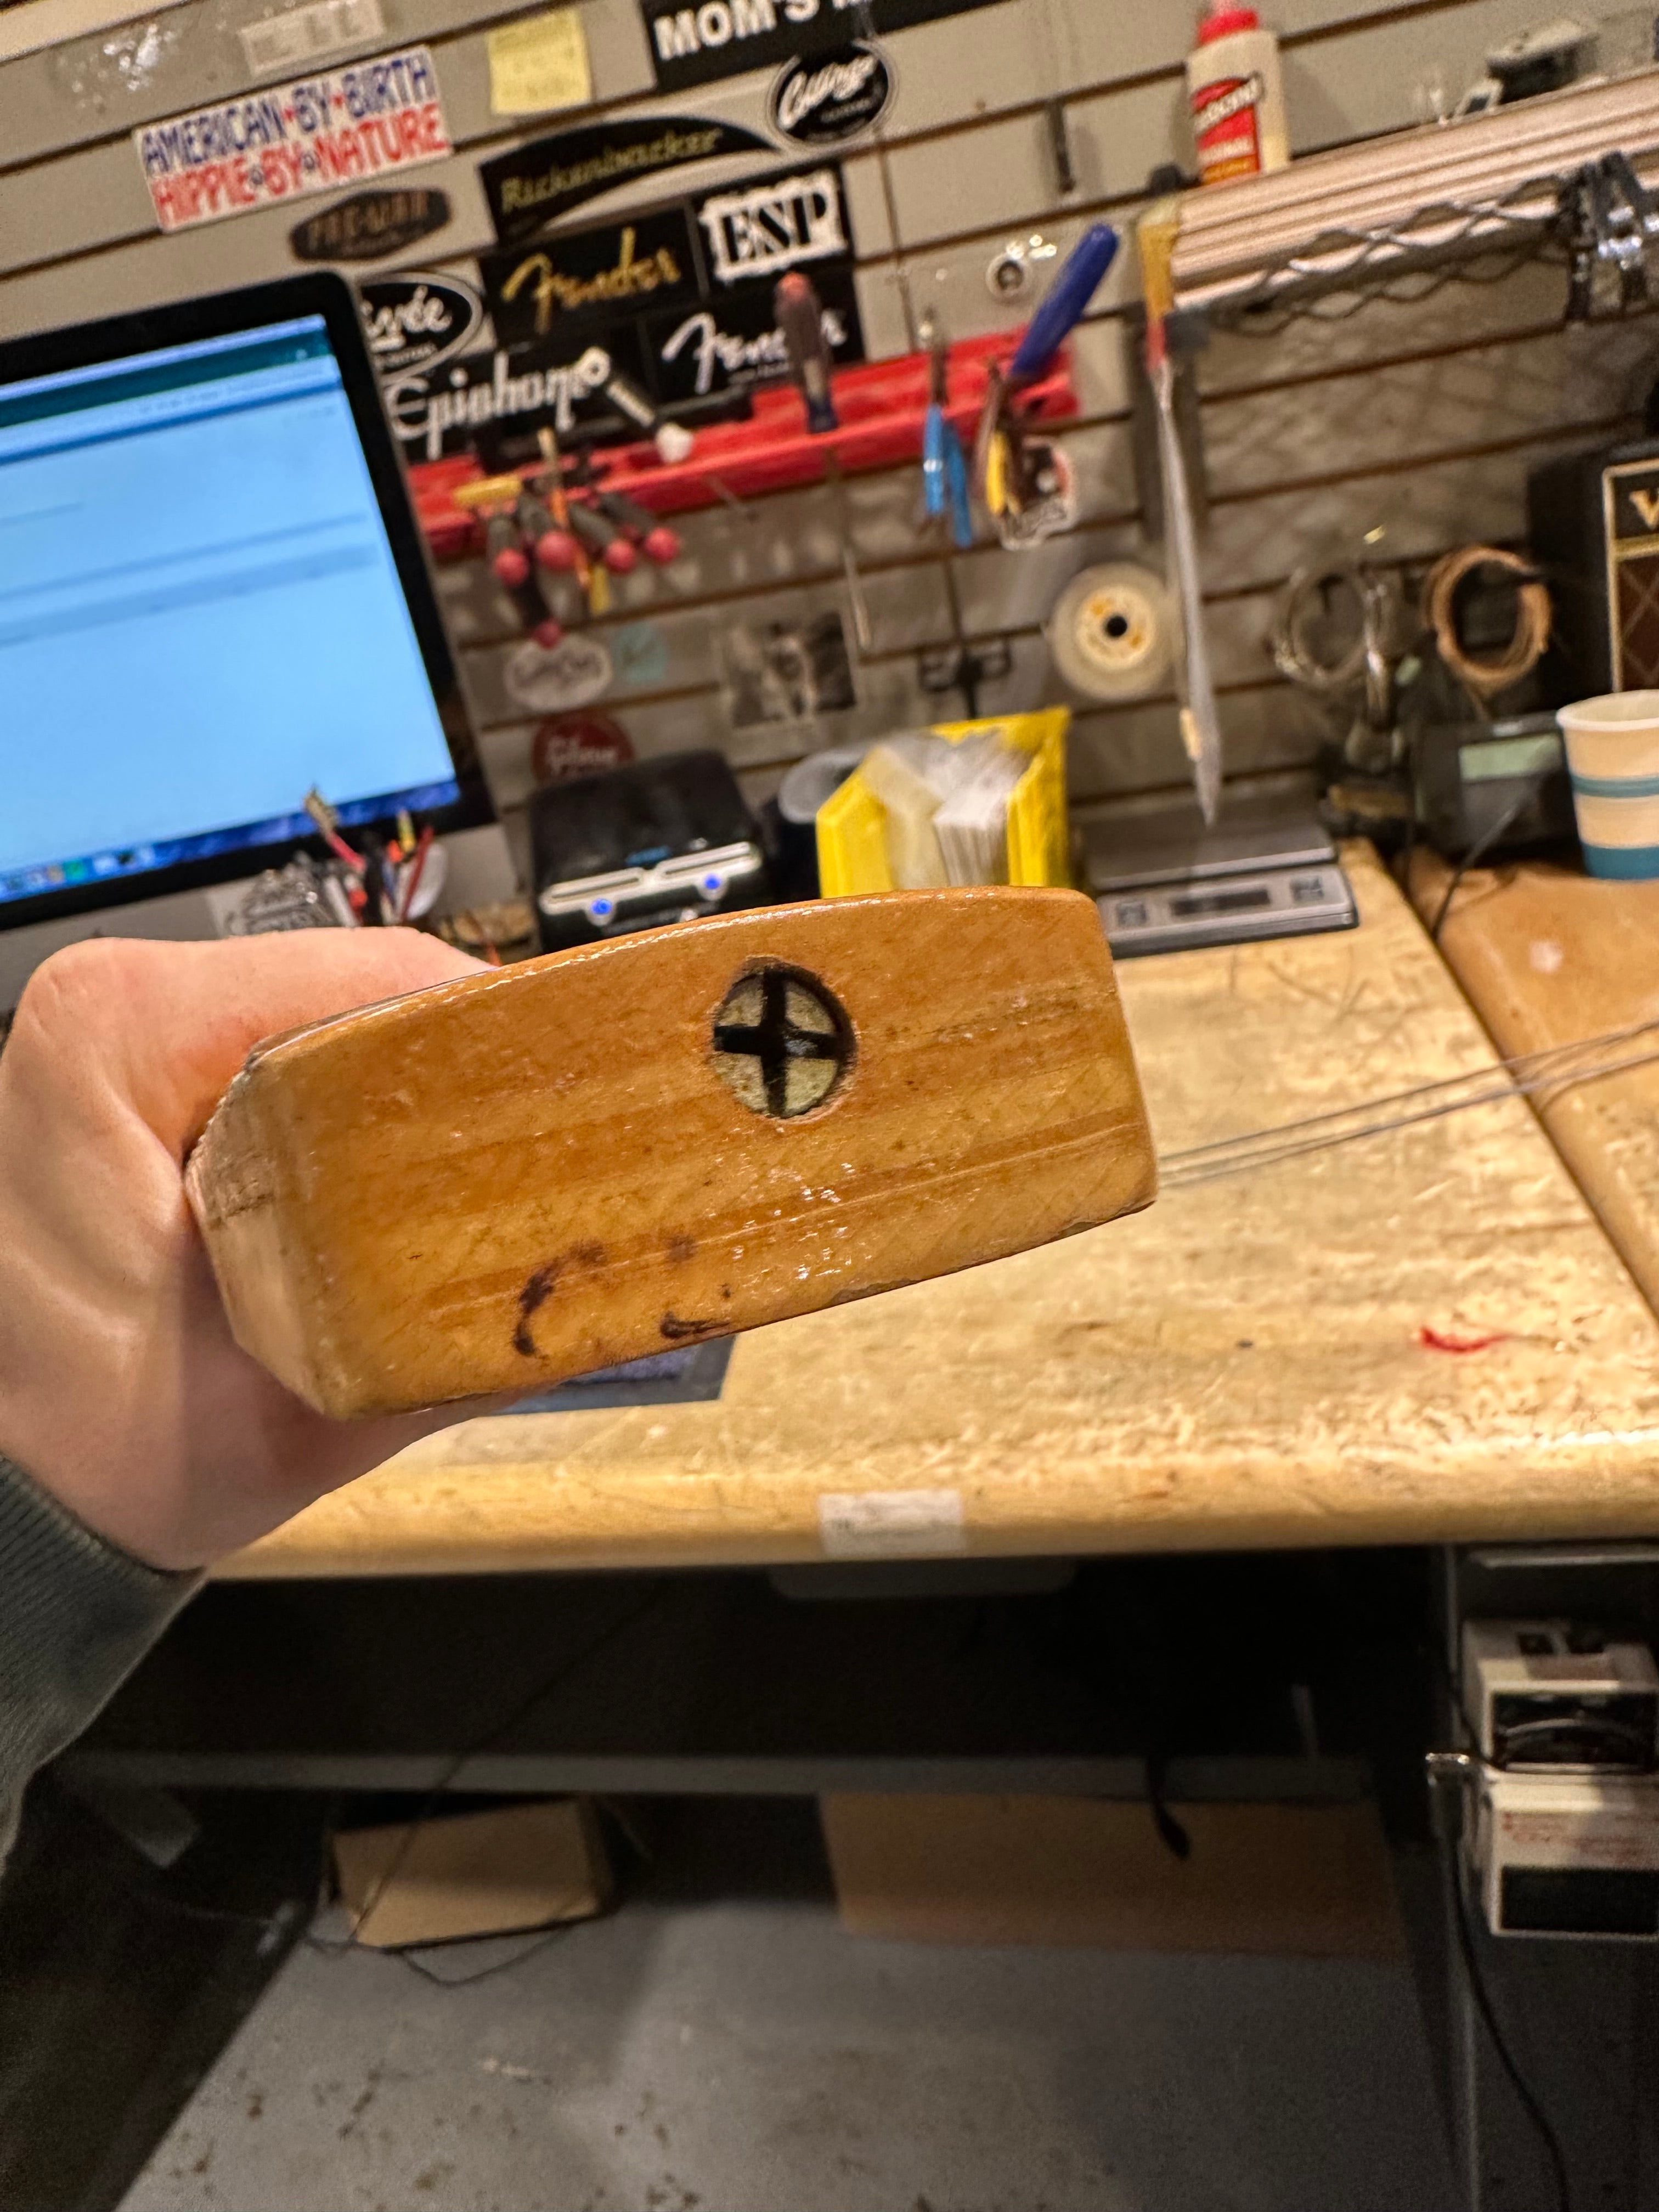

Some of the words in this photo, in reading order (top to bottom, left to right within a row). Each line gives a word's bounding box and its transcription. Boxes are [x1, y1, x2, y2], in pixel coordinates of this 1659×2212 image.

[653, 0, 822, 61] MOMS
[142, 94, 287, 174] AMERICAN
[292, 81, 331, 133] BY
[342, 50, 438, 119] BIRTH
[260, 140, 303, 195] BY
[313, 103, 449, 183] NATURE
[500, 127, 724, 215] Rickenbacker
[716, 187, 833, 268] ESP
[500, 226, 681, 335] Fender
[661, 312, 847, 395] Fenr
